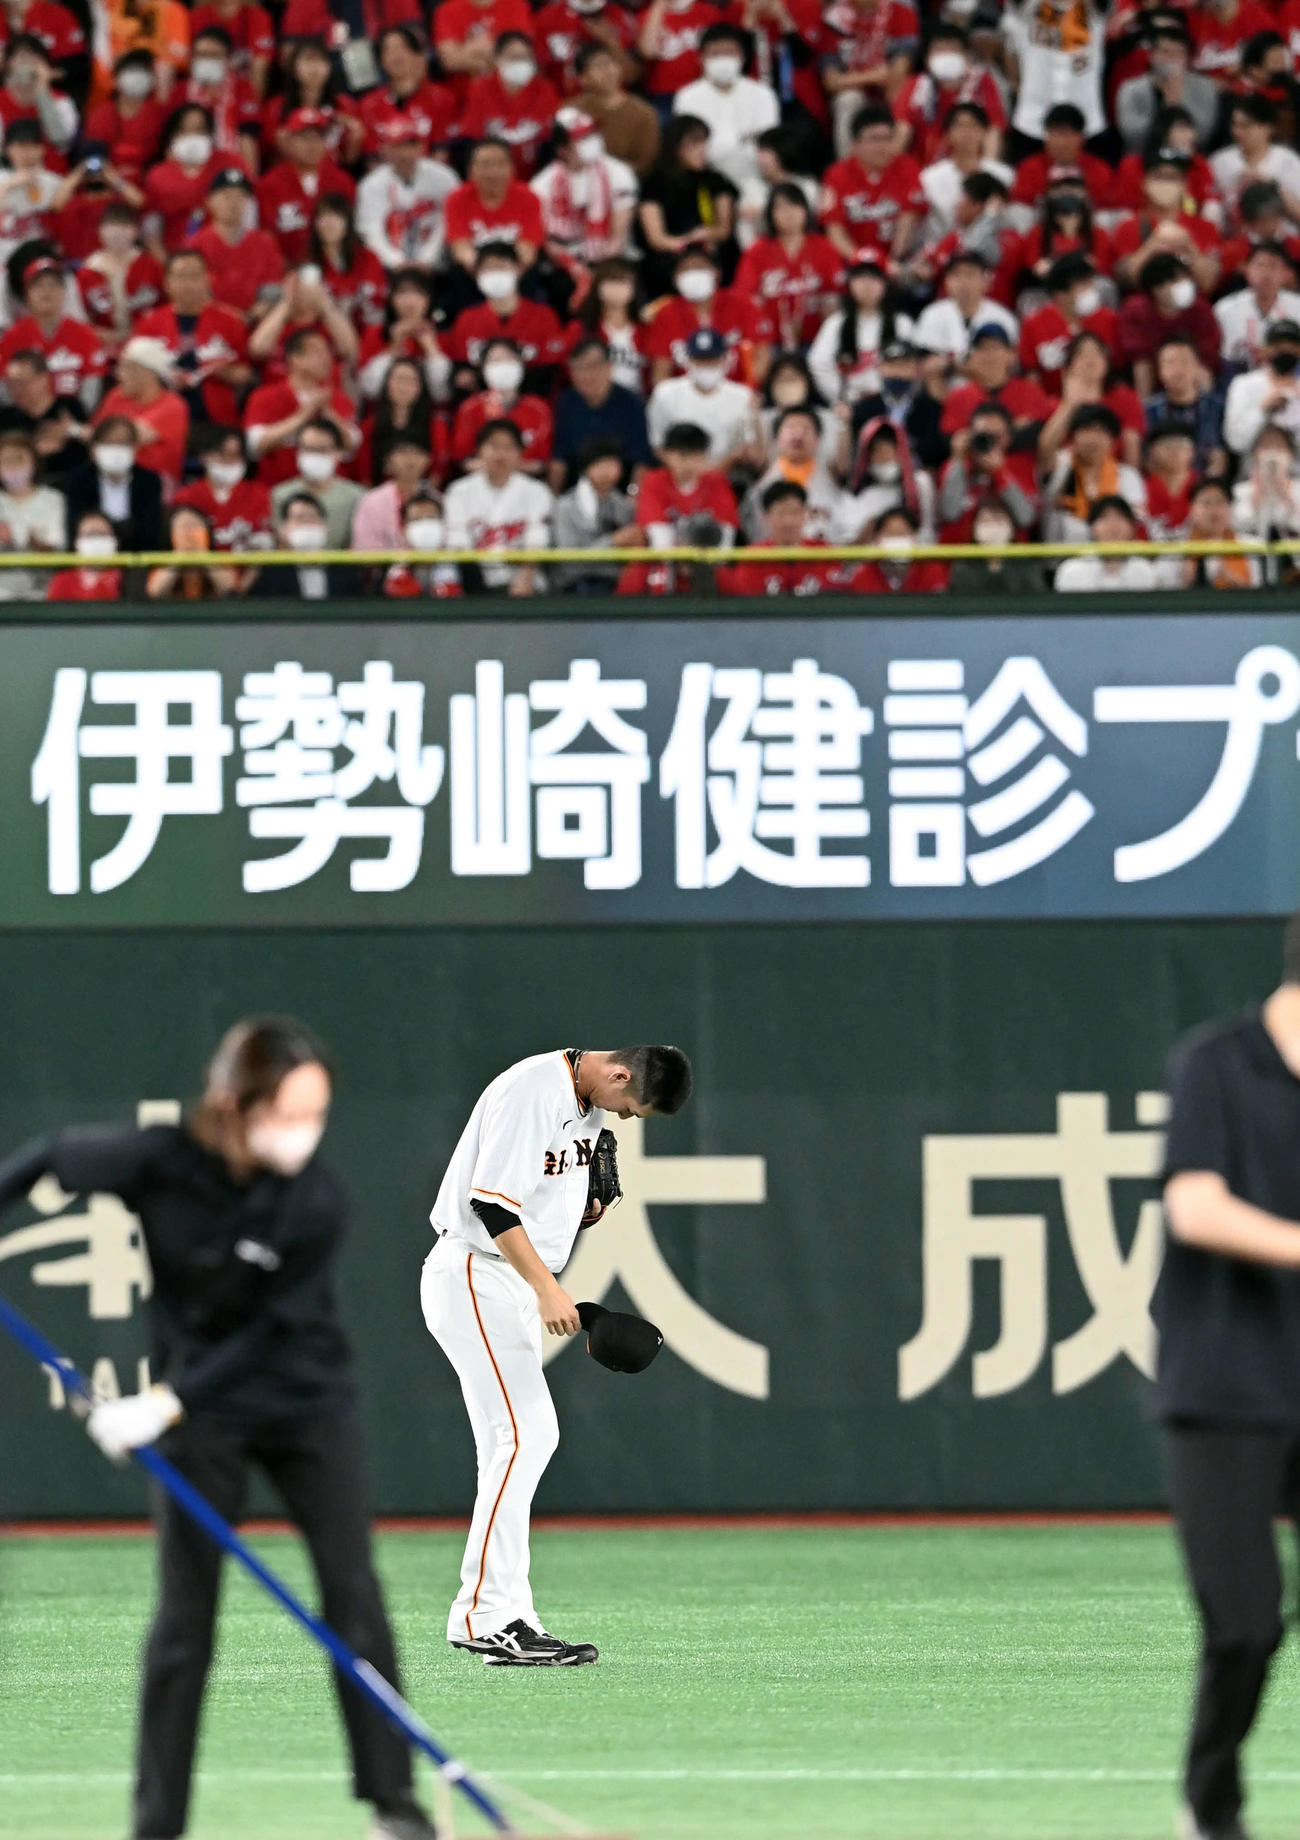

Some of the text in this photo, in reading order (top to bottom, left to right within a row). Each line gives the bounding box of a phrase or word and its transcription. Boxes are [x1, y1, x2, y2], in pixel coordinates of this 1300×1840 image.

[31, 644, 1300, 895] 伊勢崎健診プ
